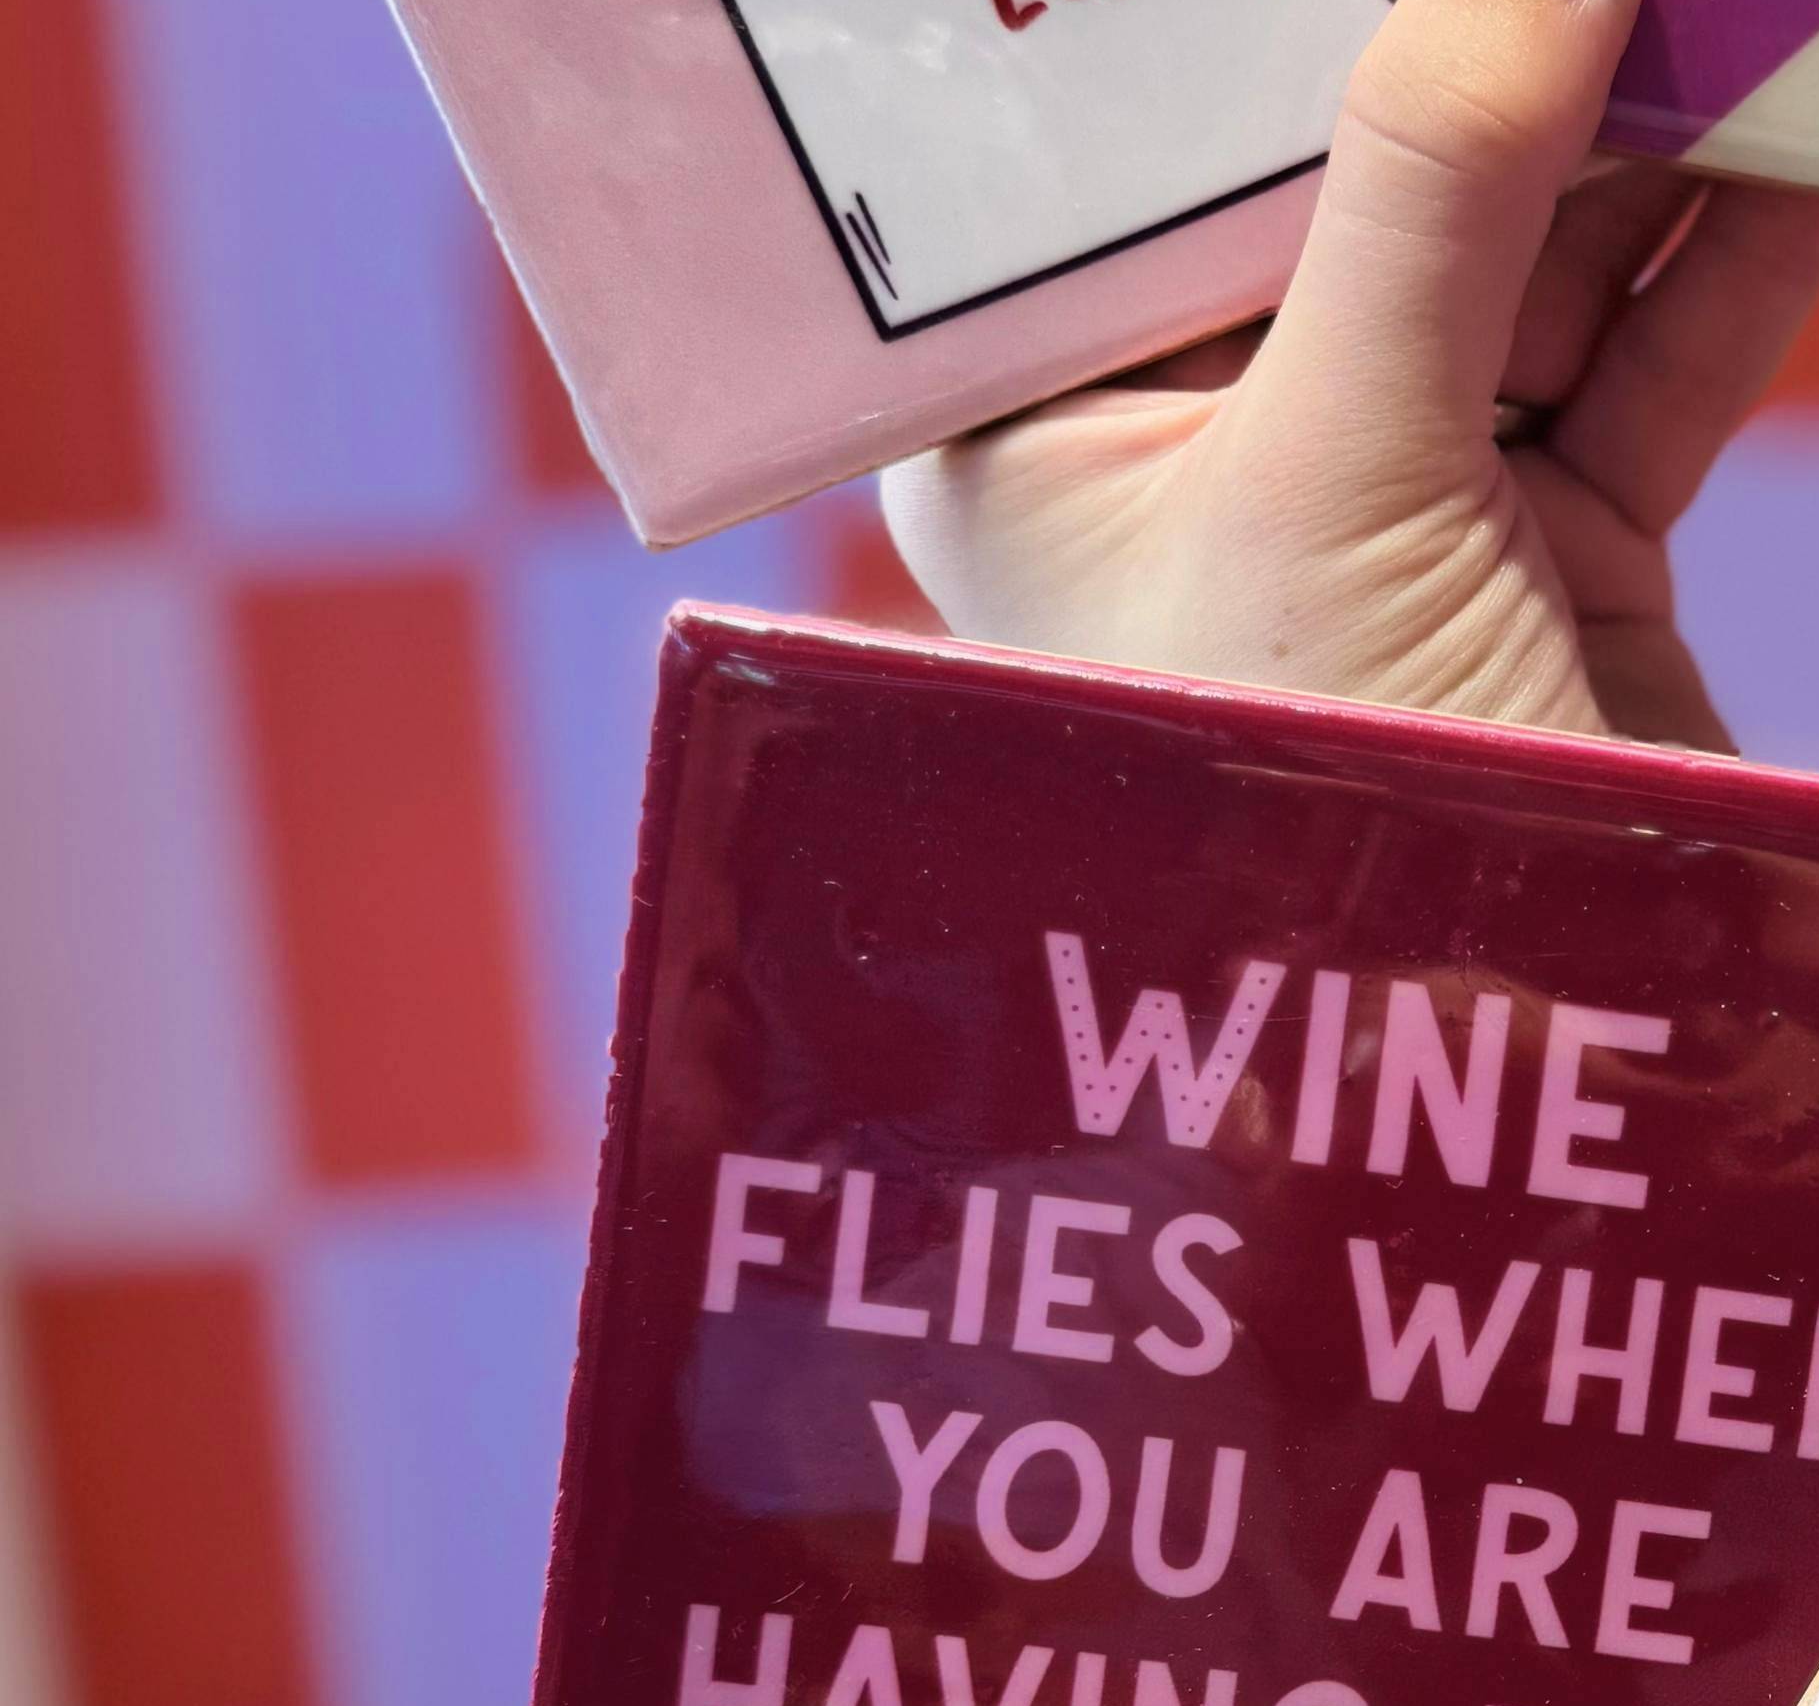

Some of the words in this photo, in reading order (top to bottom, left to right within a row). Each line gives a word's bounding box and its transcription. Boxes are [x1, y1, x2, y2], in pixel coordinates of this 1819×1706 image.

[1043, 930, 1672, 1210] WINE
[700, 1152, 1245, 1378] FLIES
[868, 1400, 1246, 1600] YOU
[1329, 1468, 1713, 1666] ARE
